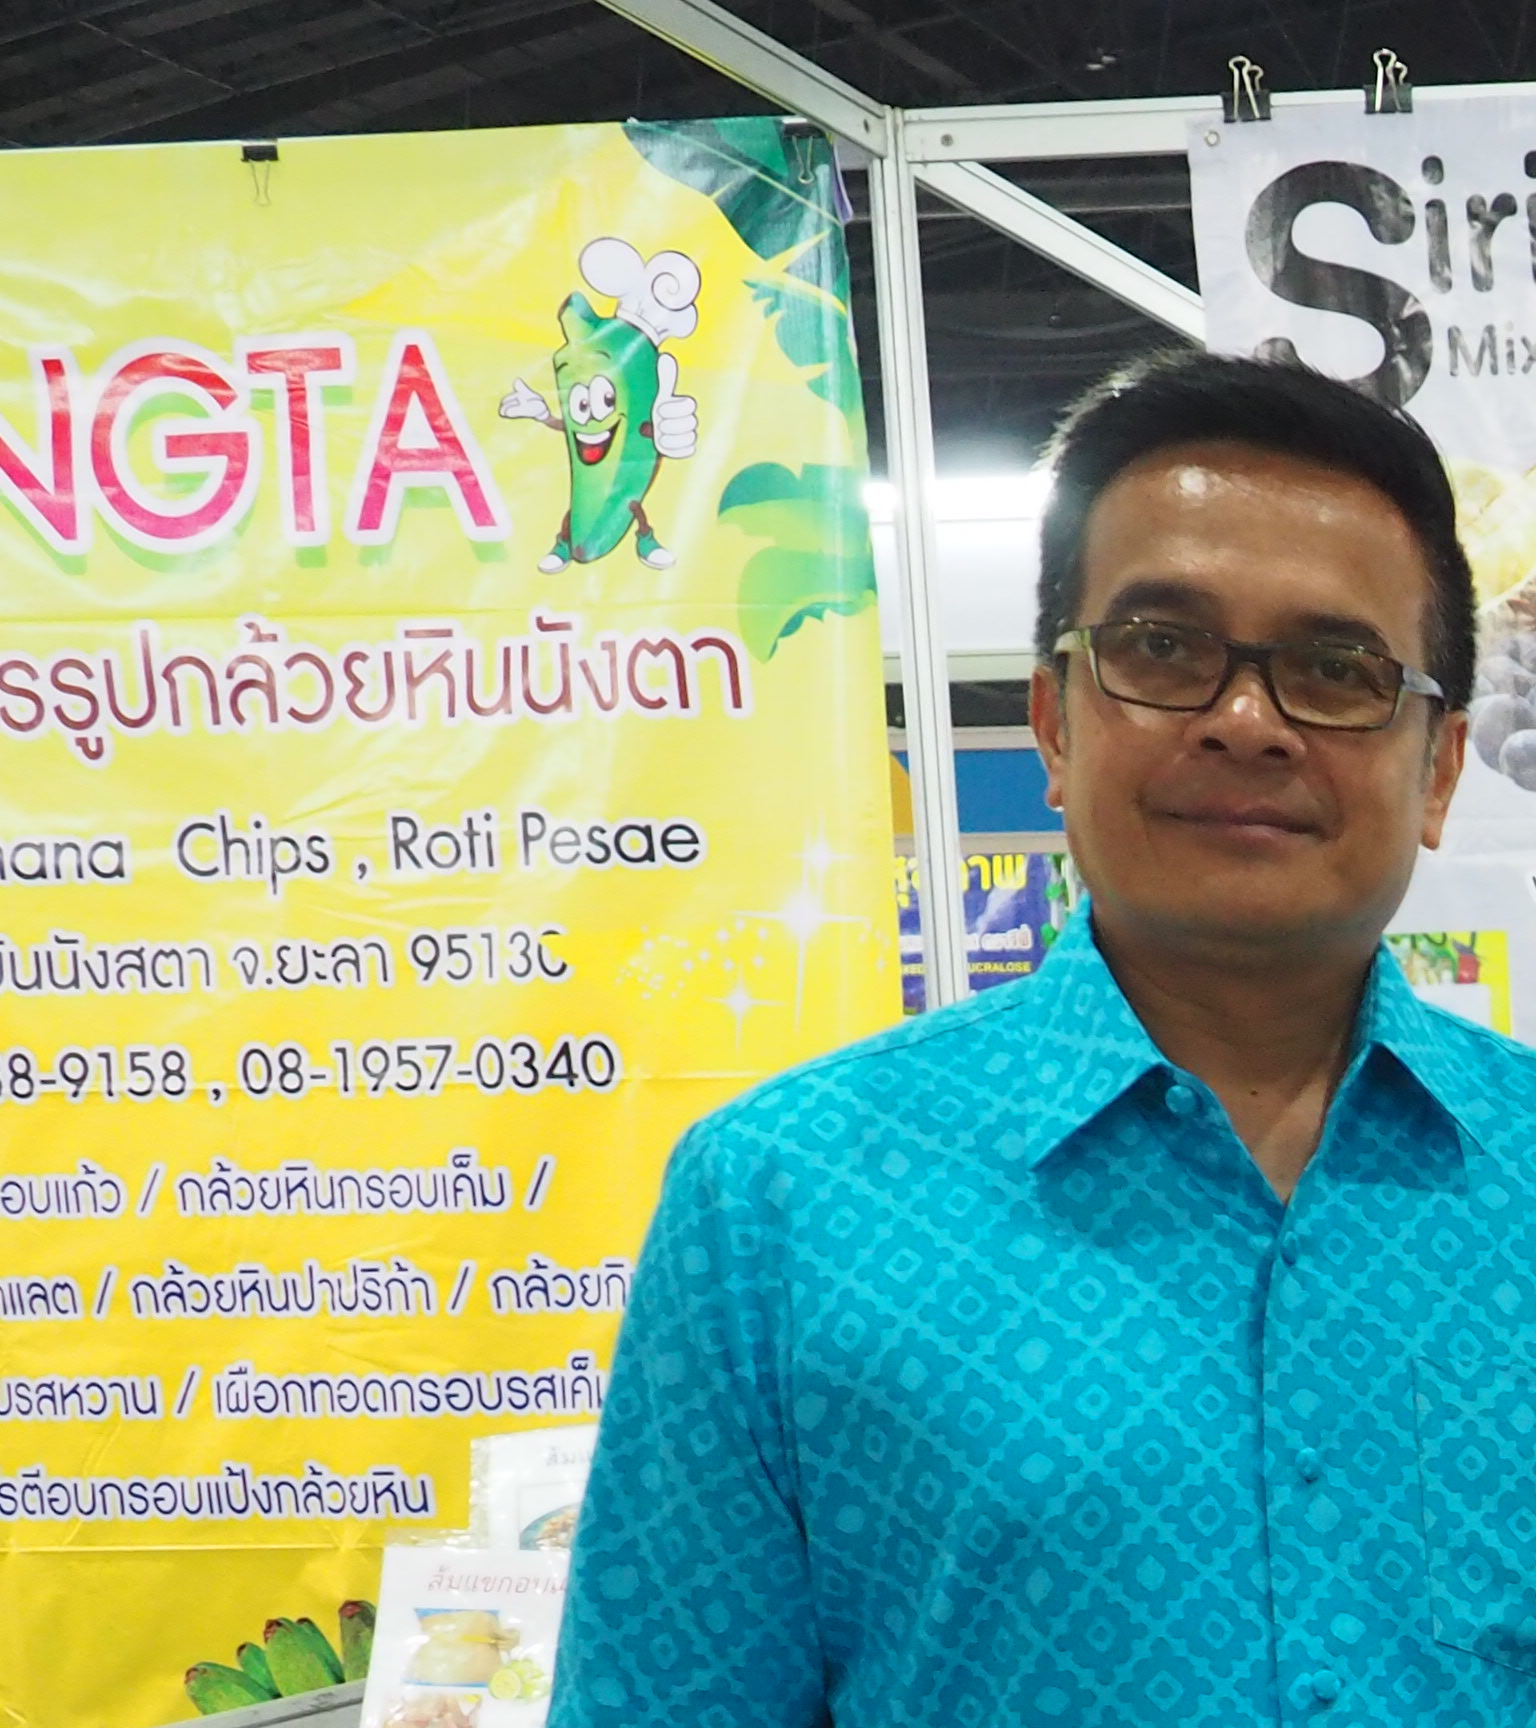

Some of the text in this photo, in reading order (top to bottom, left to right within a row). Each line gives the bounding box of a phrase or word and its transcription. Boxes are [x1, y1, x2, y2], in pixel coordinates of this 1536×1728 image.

[0, 344, 498, 542] NGTA
[0, 838, 126, 882] ana
[176, 814, 330, 896] Chips
[390, 810, 496, 871] Roti
[521, 811, 701, 867] Pesae
[0, 935, 211, 991] นนังสตา
[233, 941, 390, 986] จ.ยะลา
[0, 1050, 187, 1099] 8-9158
[242, 1040, 616, 1094] 08-1957-0340
[178, 1153, 506, 1212] กล้วยหินกรอบเค็ม
[132, 1260, 432, 1313] กล้วยหินปาปริก้า
[492, 1259, 634, 1310] กล้วยกิ
